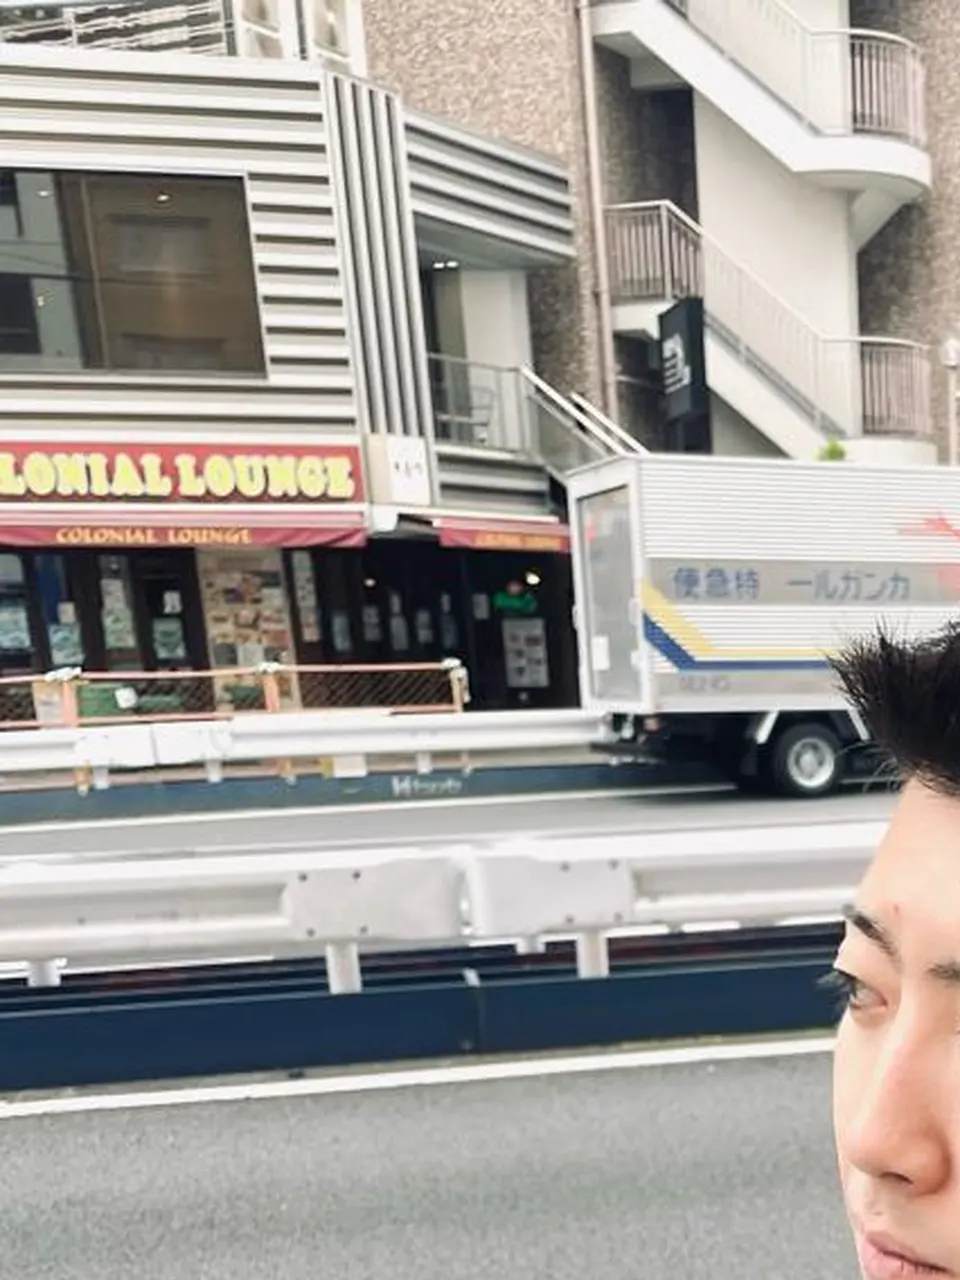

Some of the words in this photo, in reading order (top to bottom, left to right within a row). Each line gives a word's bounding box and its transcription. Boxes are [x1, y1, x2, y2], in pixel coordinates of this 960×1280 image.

[174, 453, 355, 498] LOUNGE
[56, 527, 158, 544] COLONIAL
[168, 527, 252, 544] LOUNGE
